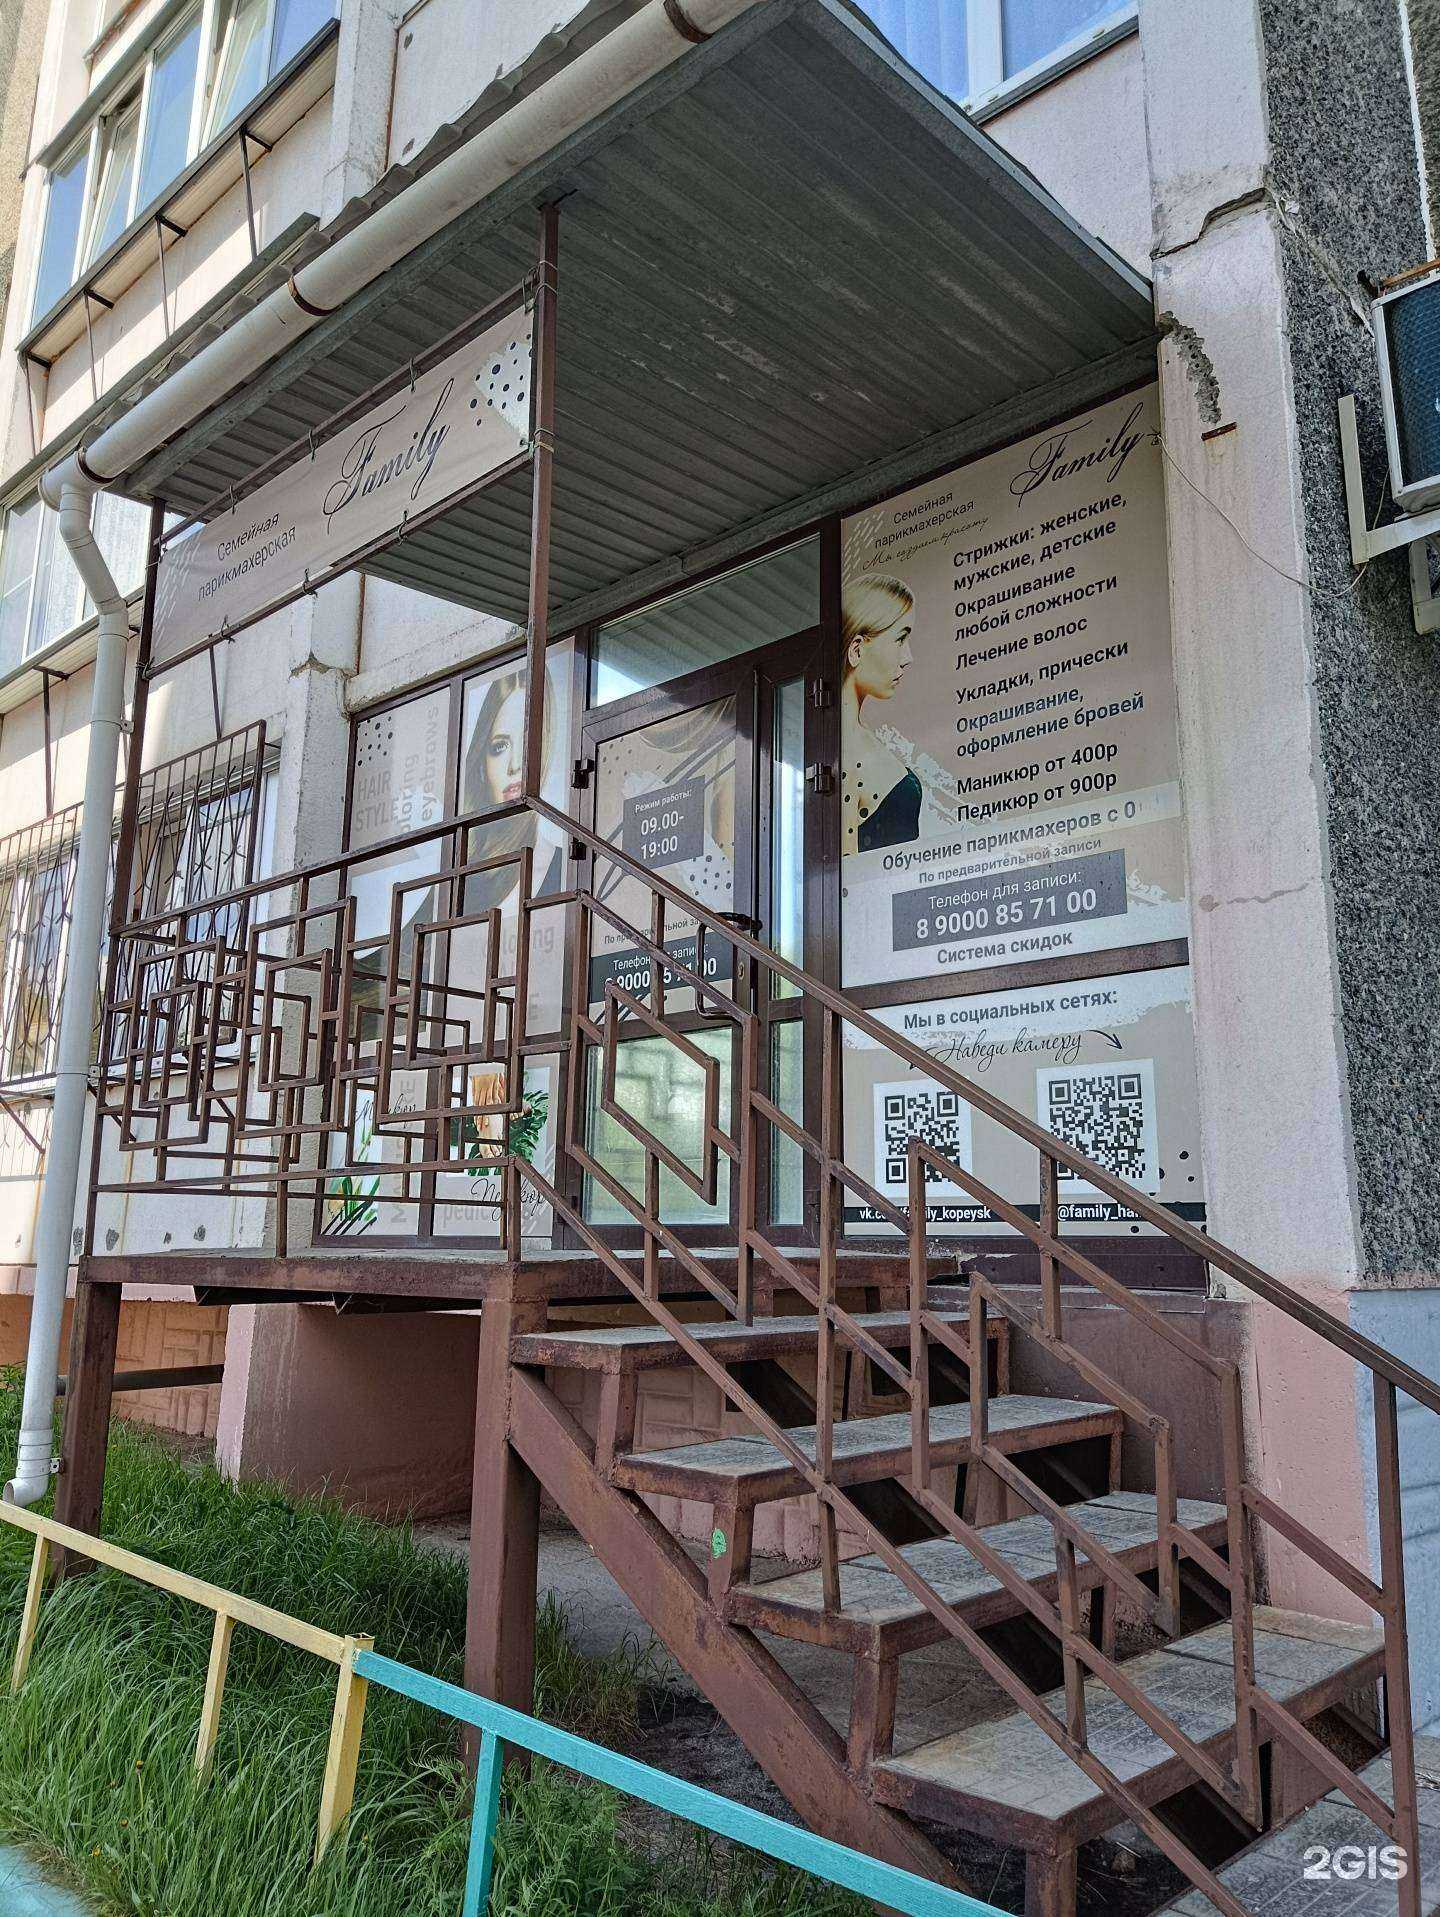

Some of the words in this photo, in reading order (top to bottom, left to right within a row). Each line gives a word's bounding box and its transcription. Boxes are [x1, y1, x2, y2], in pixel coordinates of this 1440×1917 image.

[322, 378, 455, 535] Family
[1010, 402, 1144, 507] Family
[875, 501, 974, 549] парикмахерская
[893, 492, 953, 524] Семейная
[953, 526, 1036, 568] Стрижки:
[1040, 491, 1127, 537] женские,
[217, 512, 280, 561] Семейная
[953, 553, 1036, 591] мужские,
[1040, 519, 1116, 562] детские
[199, 526, 296, 601] парикмахерская
[954, 565, 1076, 618] Окрашивание
[954, 609, 1010, 642] любой
[1014, 575, 1118, 621] сложности
[955, 635, 1029, 671] Лечение
[1033, 618, 1088, 645] волос
[956, 672, 1034, 704] Укладки,
[1039, 642, 1128, 681] прически
[956, 687, 1084, 734] Окрашивание,
[956, 718, 1069, 758] оформление
[1074, 692, 1144, 728] бровей
[357, 770, 391, 802] HAIR
[957, 762, 1041, 795] Маникюр
[1045, 757, 1066, 774] от
[1071, 742, 1118, 767] 400р
[635, 799, 660, 813] Режим
[662, 788, 692, 806] работы:
[957, 791, 1039, 822] Педикюр
[1043, 786, 1065, 802] от
[1070, 771, 1117, 797] 900р
[641, 810, 684, 835] 09.00-
[883, 841, 961, 871] Обучение
[966, 813, 1102, 855] парикмахеров
[1107, 808, 1118, 822] с
[641, 835, 678, 860] 19:00
[919, 872, 935, 884] По
[938, 849, 1051, 882] предварительной
[1054, 839, 1101, 857] записи
[916, 918, 929, 939] 8
[935, 908, 989, 937] 9000
[995, 901, 1024, 926] 85
[1030, 896, 1056, 919] 71
[1067, 888, 1097, 913] 00
[928, 891, 989, 910] Телефон
[992, 884, 1020, 901] для
[1023, 871, 1082, 892] записи:
[604, 935, 614, 944] По
[613, 955, 651, 970] Телефон
[937, 943, 1006, 965] Система
[1010, 931, 1073, 954] скидок
[904, 1013, 932, 1030] Мы
[936, 1014, 947, 1025] в
[949, 1001, 1055, 1024] социальных
[1060, 989, 1118, 1010] сетях:
[935, 1029, 1007, 1072] Наведи
[1012, 1027, 1082, 1064] камеру
